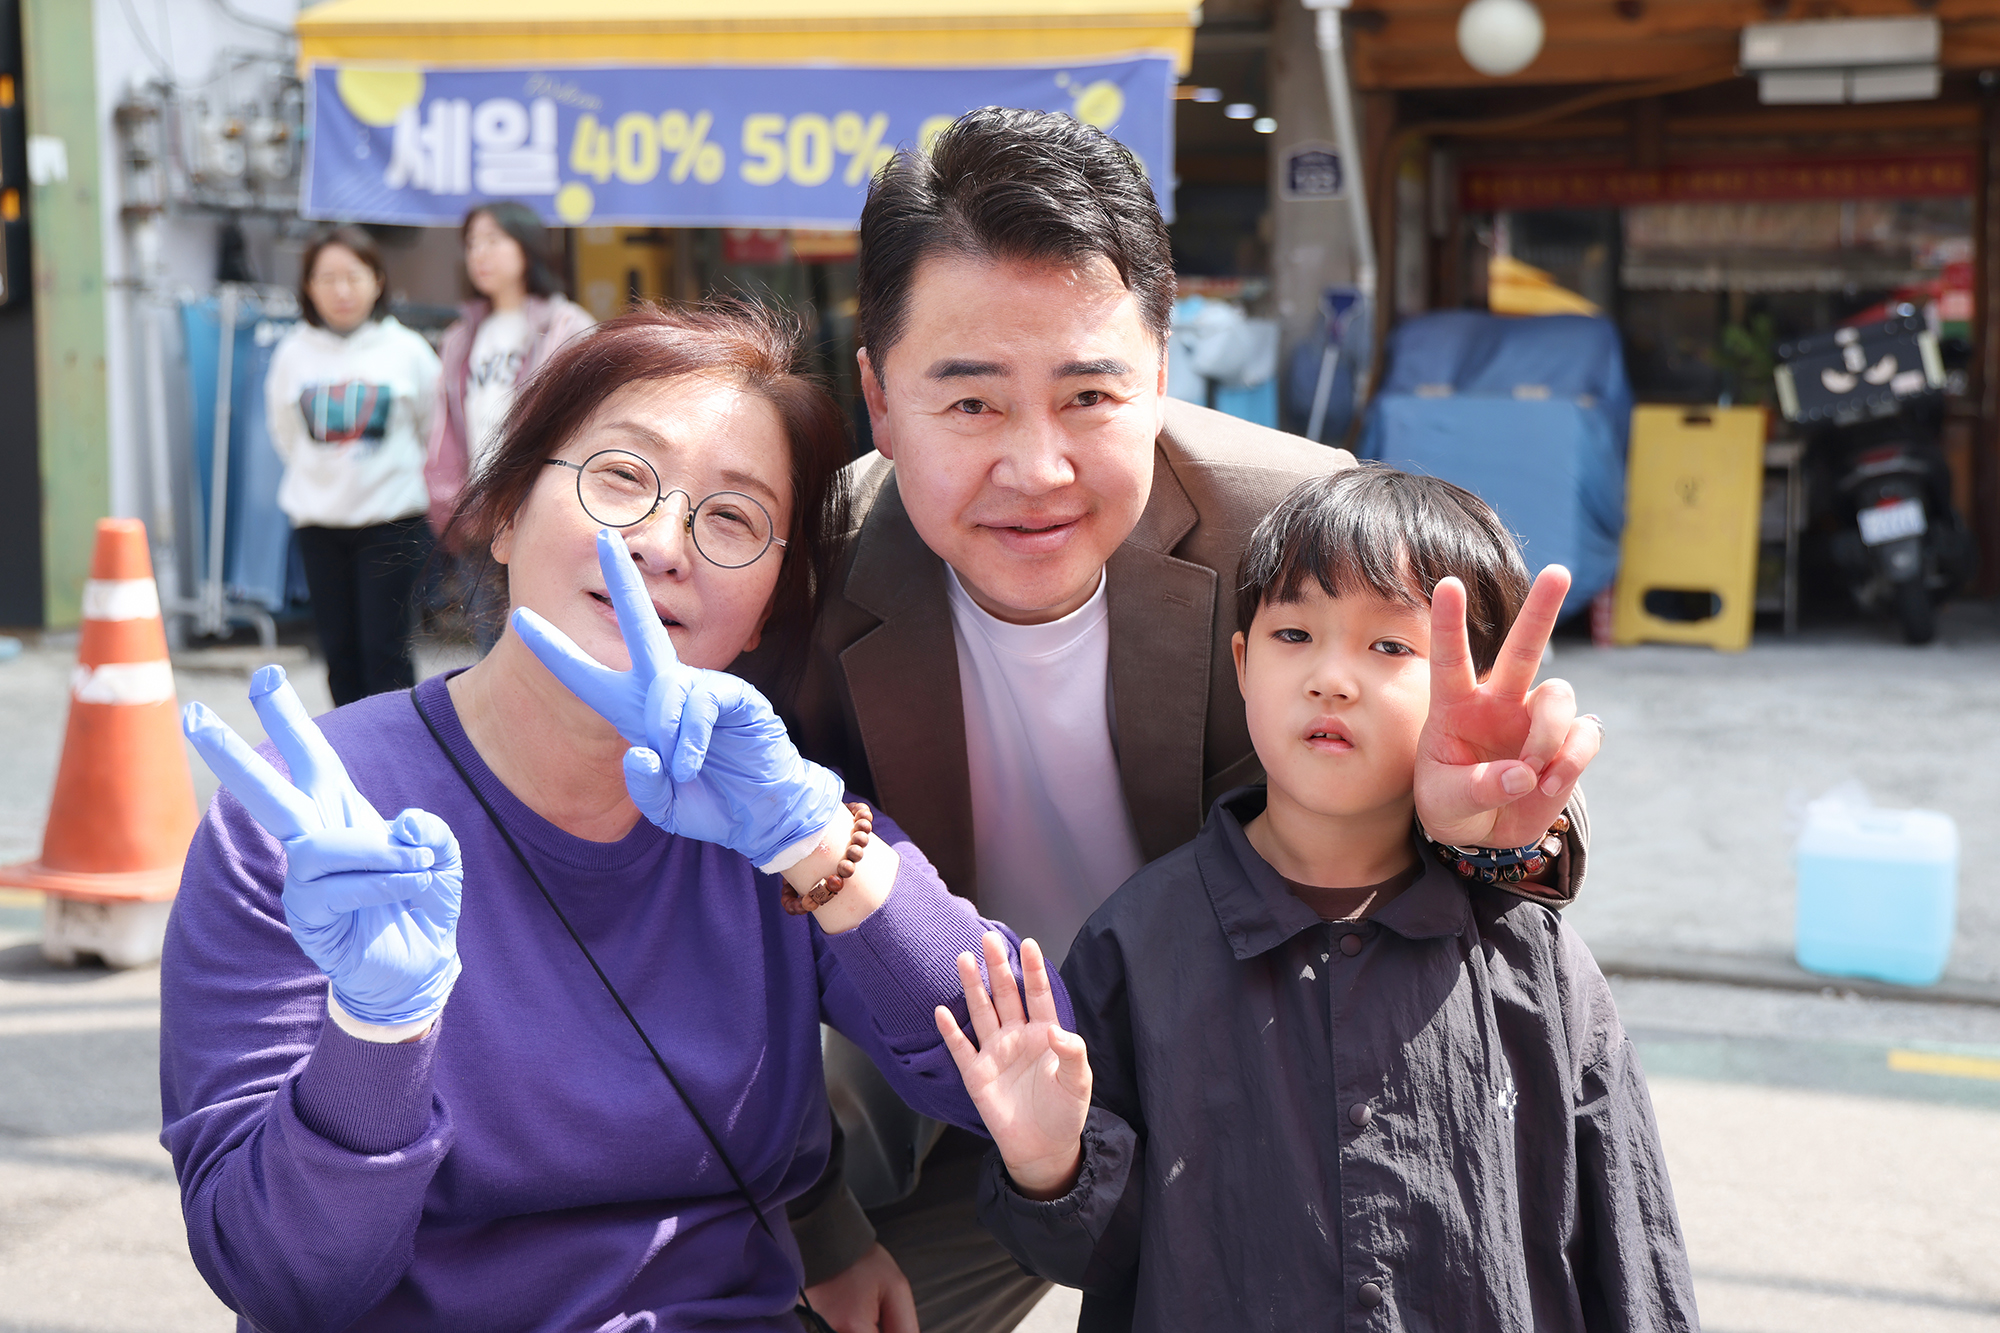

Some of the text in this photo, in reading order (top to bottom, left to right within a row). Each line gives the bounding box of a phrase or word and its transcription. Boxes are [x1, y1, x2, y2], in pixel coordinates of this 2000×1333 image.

[385, 97, 559, 194] 세일
[571, 110, 725, 185] 40%
[740, 111, 898, 187] 50%
